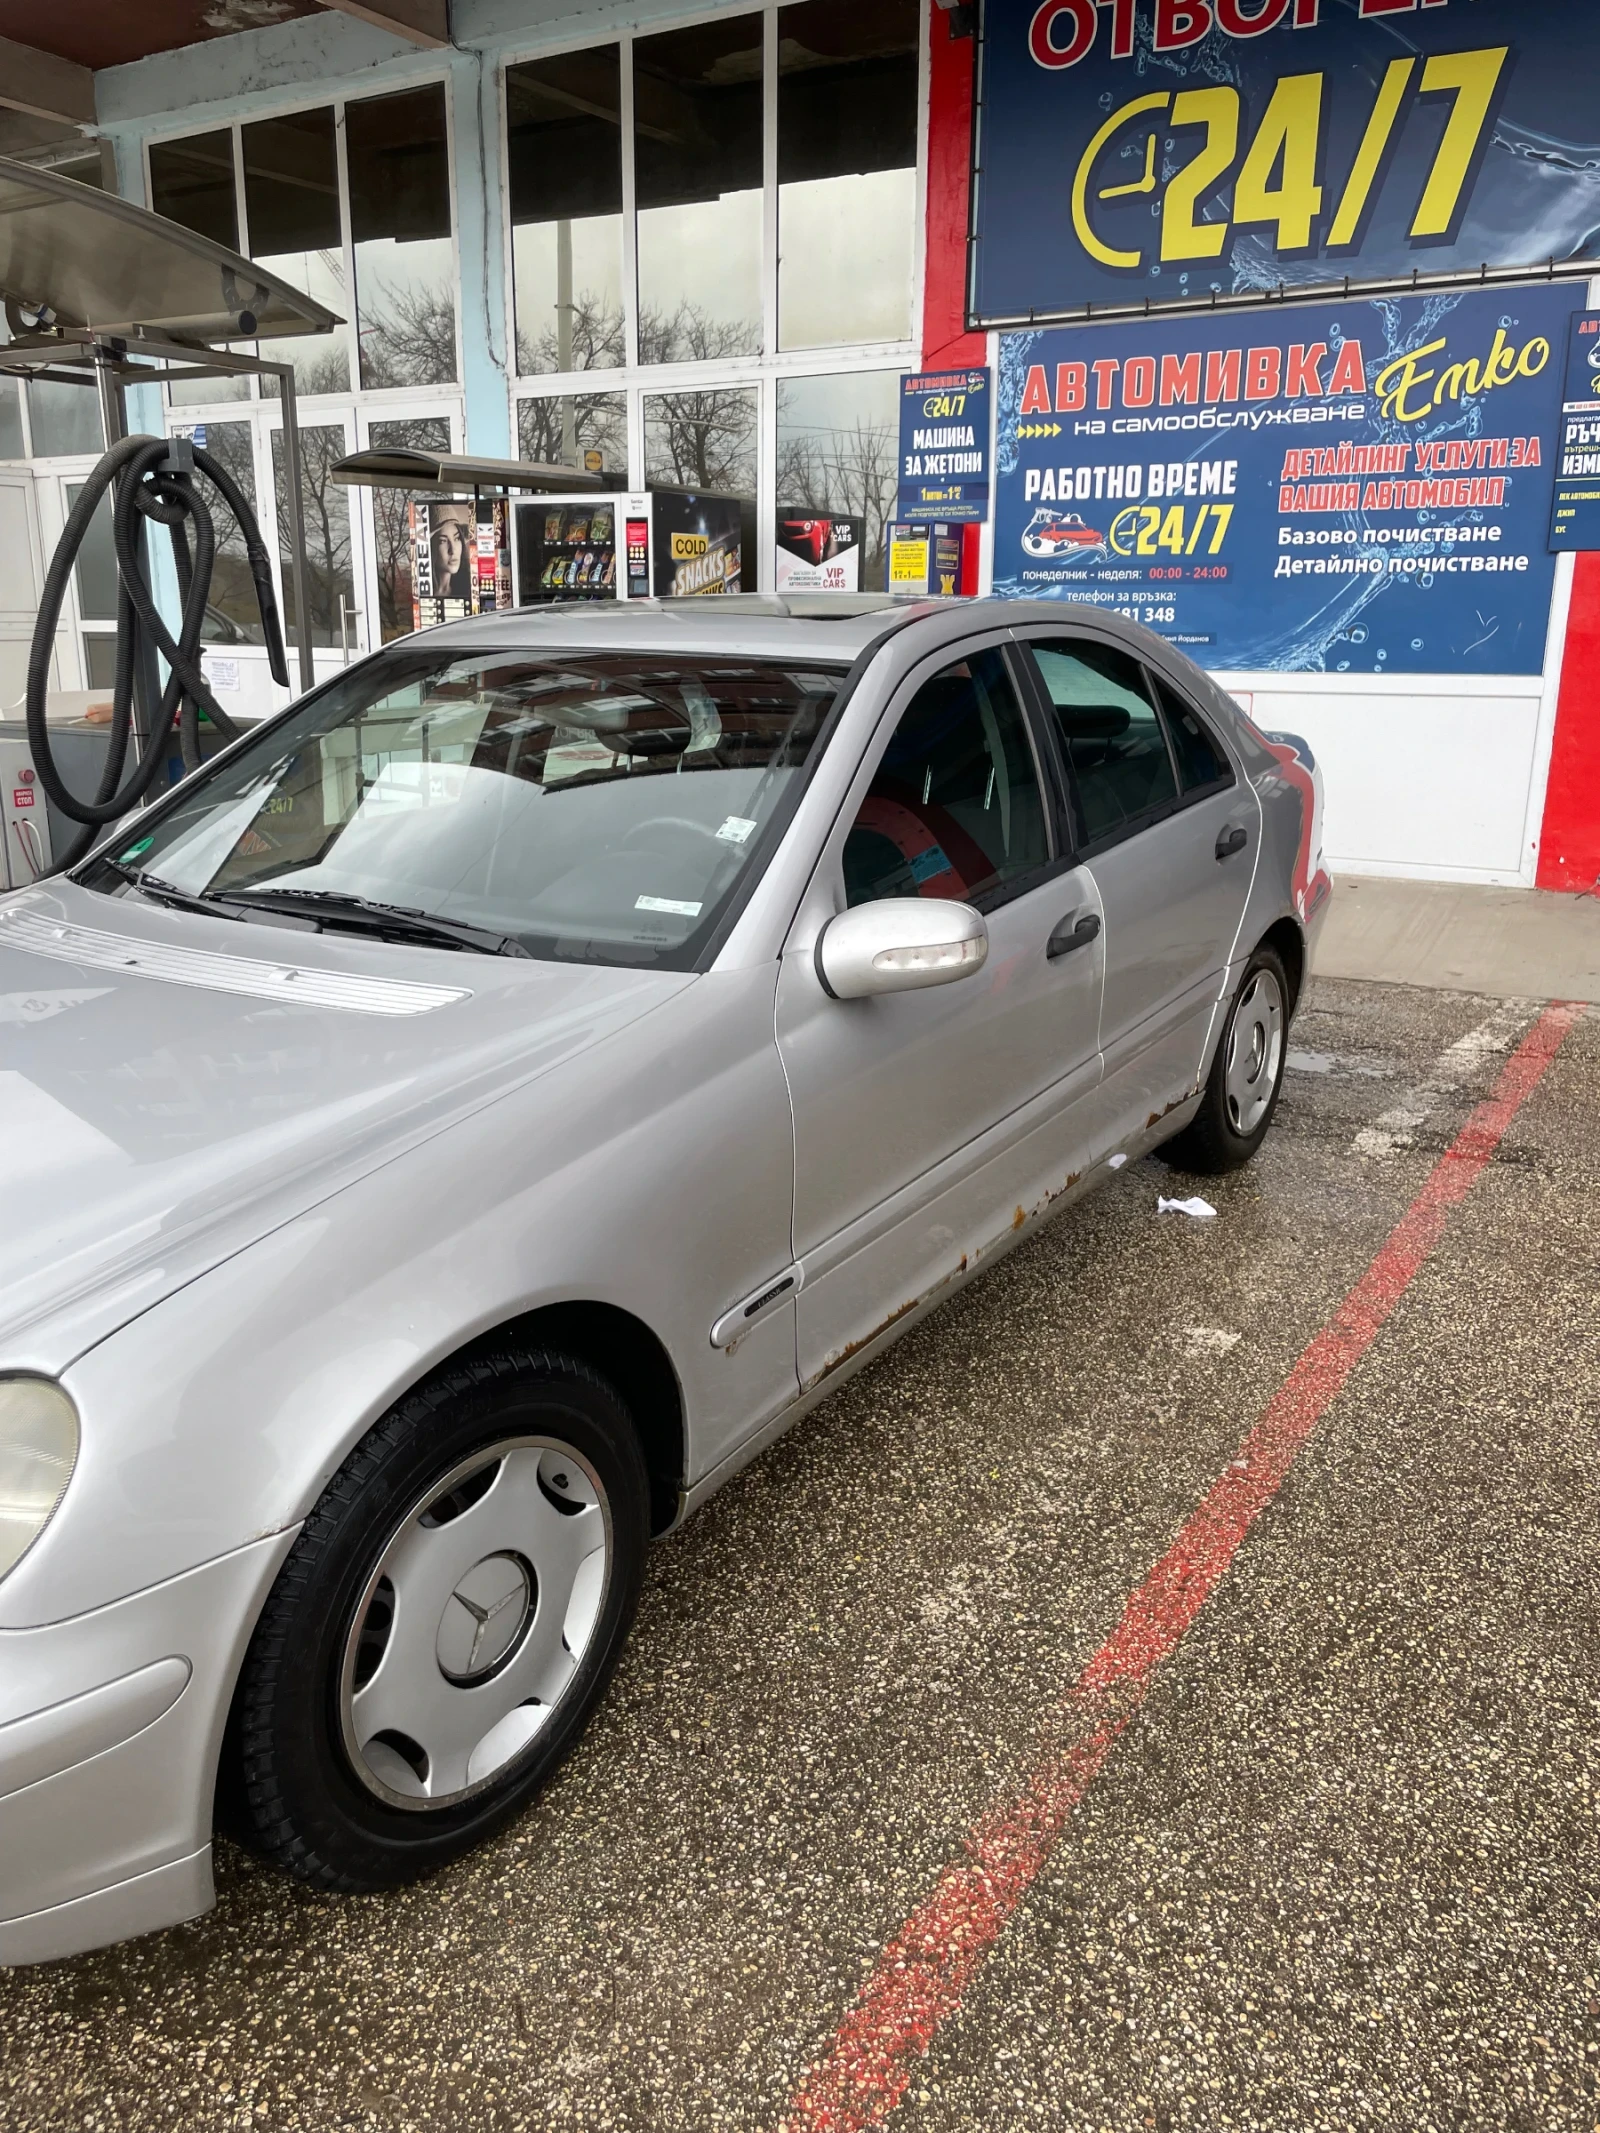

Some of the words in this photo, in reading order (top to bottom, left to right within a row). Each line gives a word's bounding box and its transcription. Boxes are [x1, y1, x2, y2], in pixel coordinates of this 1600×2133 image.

[1160, 46, 1509, 262] 24/7
[905, 374, 967, 391] АВТОМИВКА
[1019, 339, 1367, 415] АВТОМИВКА
[933, 395, 966, 418] 24/7
[1074, 418, 1106, 436] на
[1112, 401, 1365, 433] самообслужване
[913, 425, 974, 450] МАШИНА
[905, 456, 922, 476] ЗА
[924, 452, 982, 475] ЖЕТОНИ
[1280, 440, 1411, 481] ДЕТАЙЛИНГ
[1414, 438, 1511, 472] УСЛУГИ
[1510, 436, 1541, 467] ЗА
[1024, 464, 1142, 502] РАБОТНО
[1153, 459, 1238, 499] ВРЕМЕ
[1278, 482, 1360, 513] ВАШИЯ
[1362, 476, 1506, 511] АВТОМОБИЛ
[833, 534, 852, 542] CARS
[835, 525, 851, 534] VIP
[1136, 503, 1235, 556] 24/7
[1278, 527, 1357, 546] Базово
[1363, 523, 1502, 543] почистване
[416, 504, 432, 596] BREAK
[675, 538, 707, 554] COLD
[677, 549, 724, 595] SNACKS
[826, 568, 844, 578] VIP
[1022, 570, 1088, 581] понеделник
[1097, 569, 1142, 580] неделя:
[1149, 567, 1182, 579] 00:00
[1193, 566, 1228, 579] 24:00
[1274, 554, 1383, 579] Детайлно
[1388, 553, 1529, 574] почистване
[823, 579, 846, 588] CARS
[1067, 589, 1114, 605] телефон
[1116, 592, 1129, 602] за
[1132, 590, 1177, 604] връзка:
[1144, 607, 1175, 622] 348
[17, 796, 33, 806] СТОП
